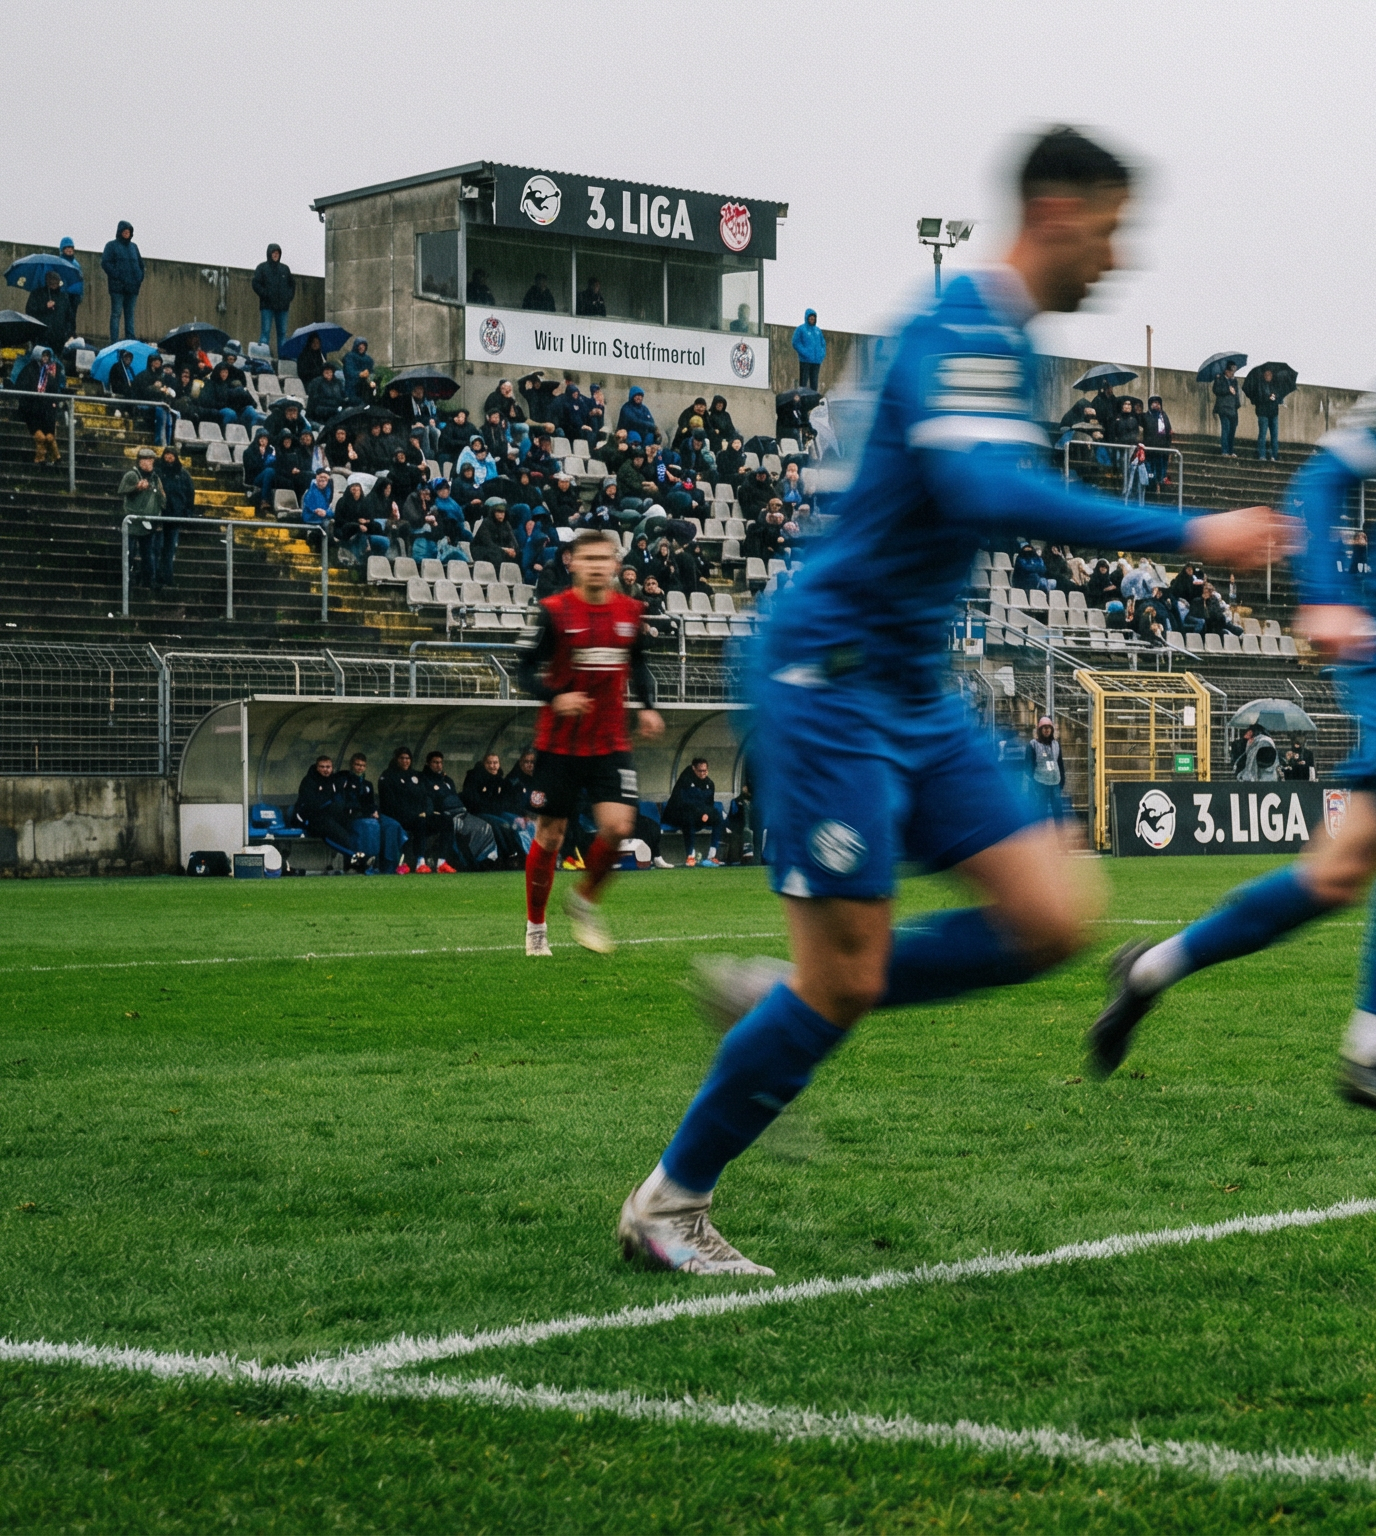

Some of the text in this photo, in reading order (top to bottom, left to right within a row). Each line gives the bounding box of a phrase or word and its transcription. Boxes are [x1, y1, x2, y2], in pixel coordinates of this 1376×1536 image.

[587, 186, 694, 241] 3. LIGA
[1193, 792, 1310, 843] 3. LIGA
